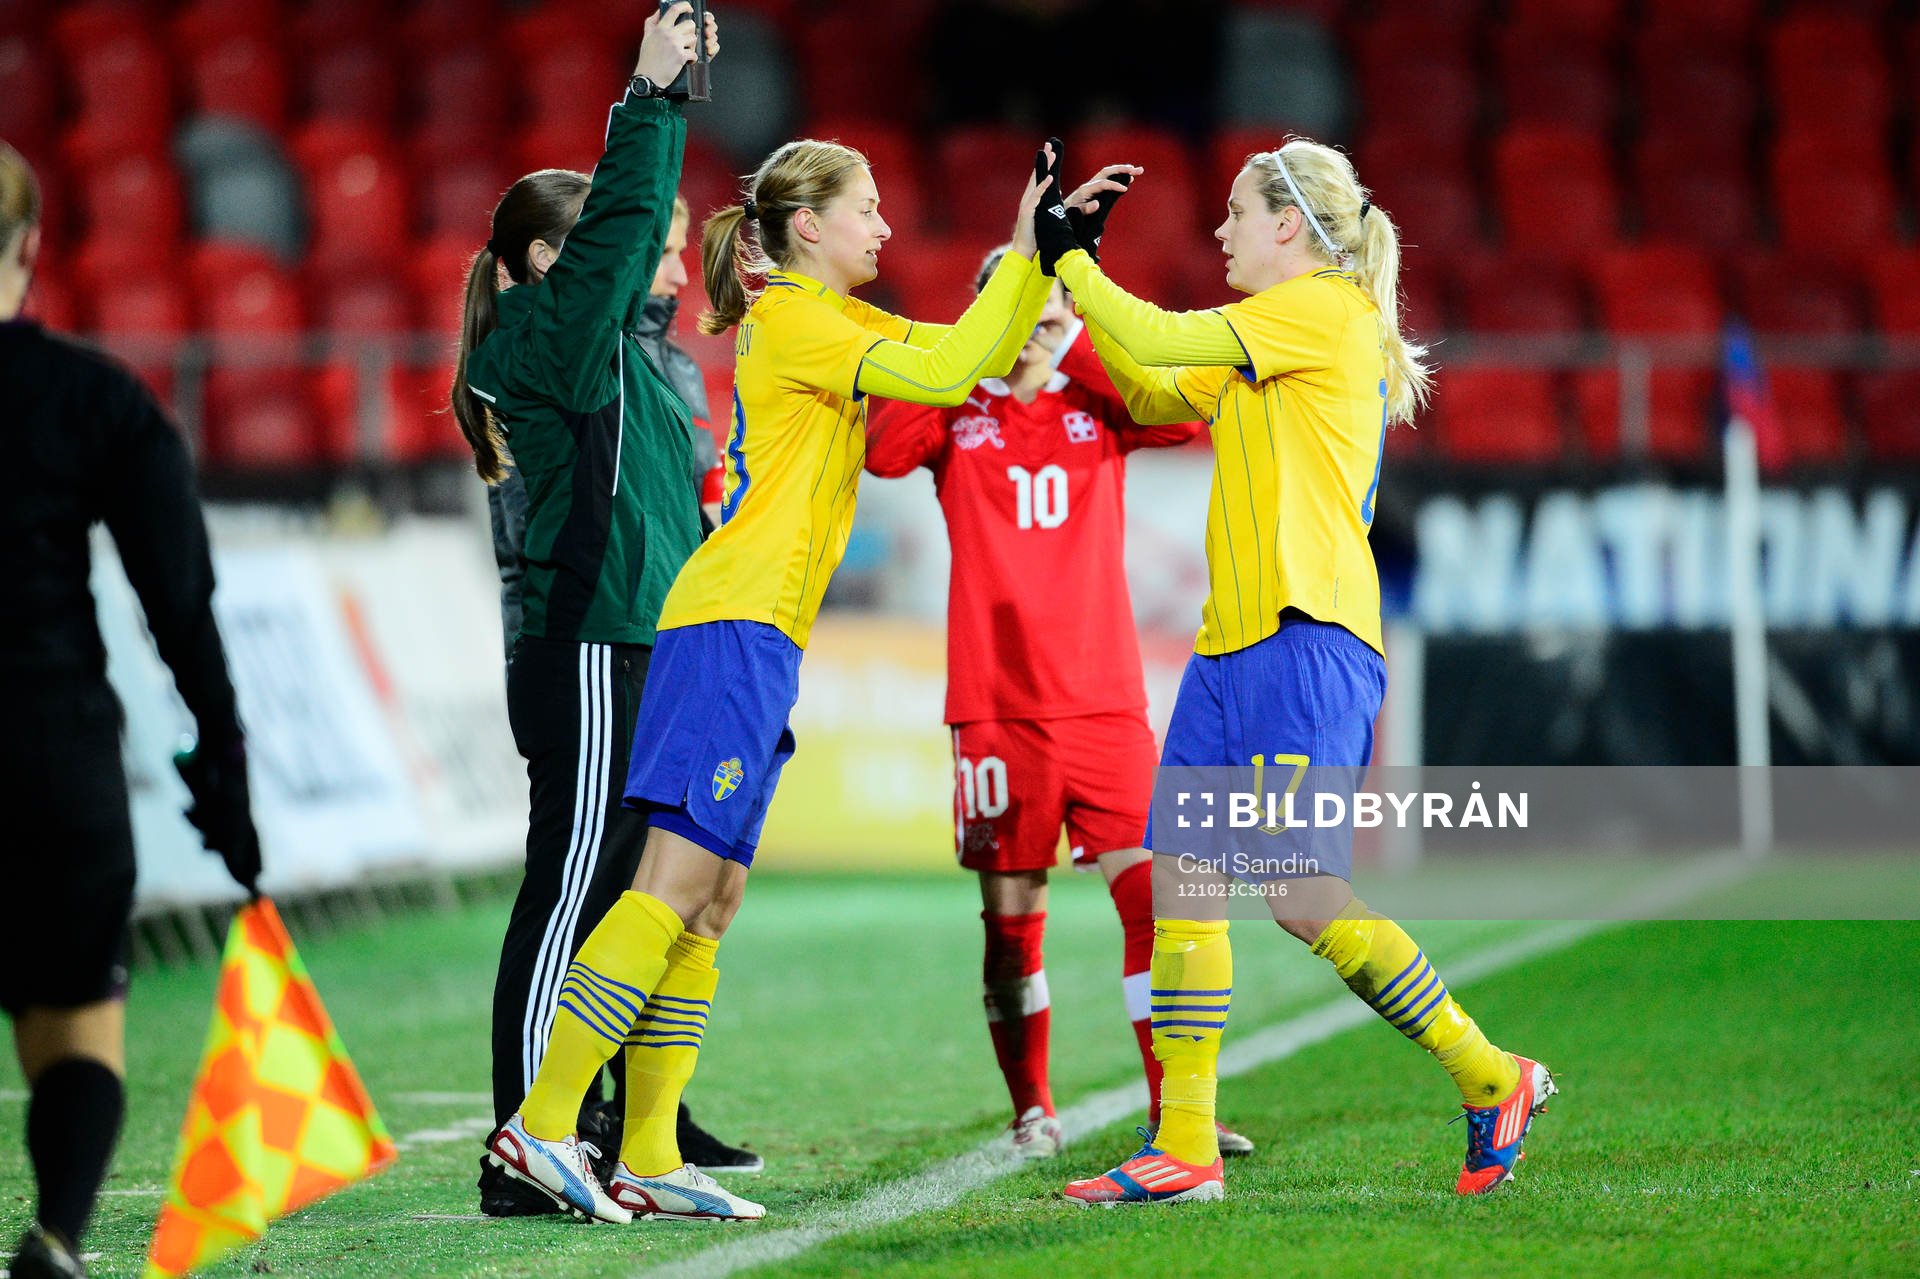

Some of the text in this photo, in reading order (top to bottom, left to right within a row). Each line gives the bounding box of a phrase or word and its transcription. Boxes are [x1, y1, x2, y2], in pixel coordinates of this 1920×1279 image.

[1007, 464, 1069, 530] 10
[1415, 486, 1920, 630] NATION
[960, 756, 1009, 819] 10
[1251, 753, 1310, 819] 17
